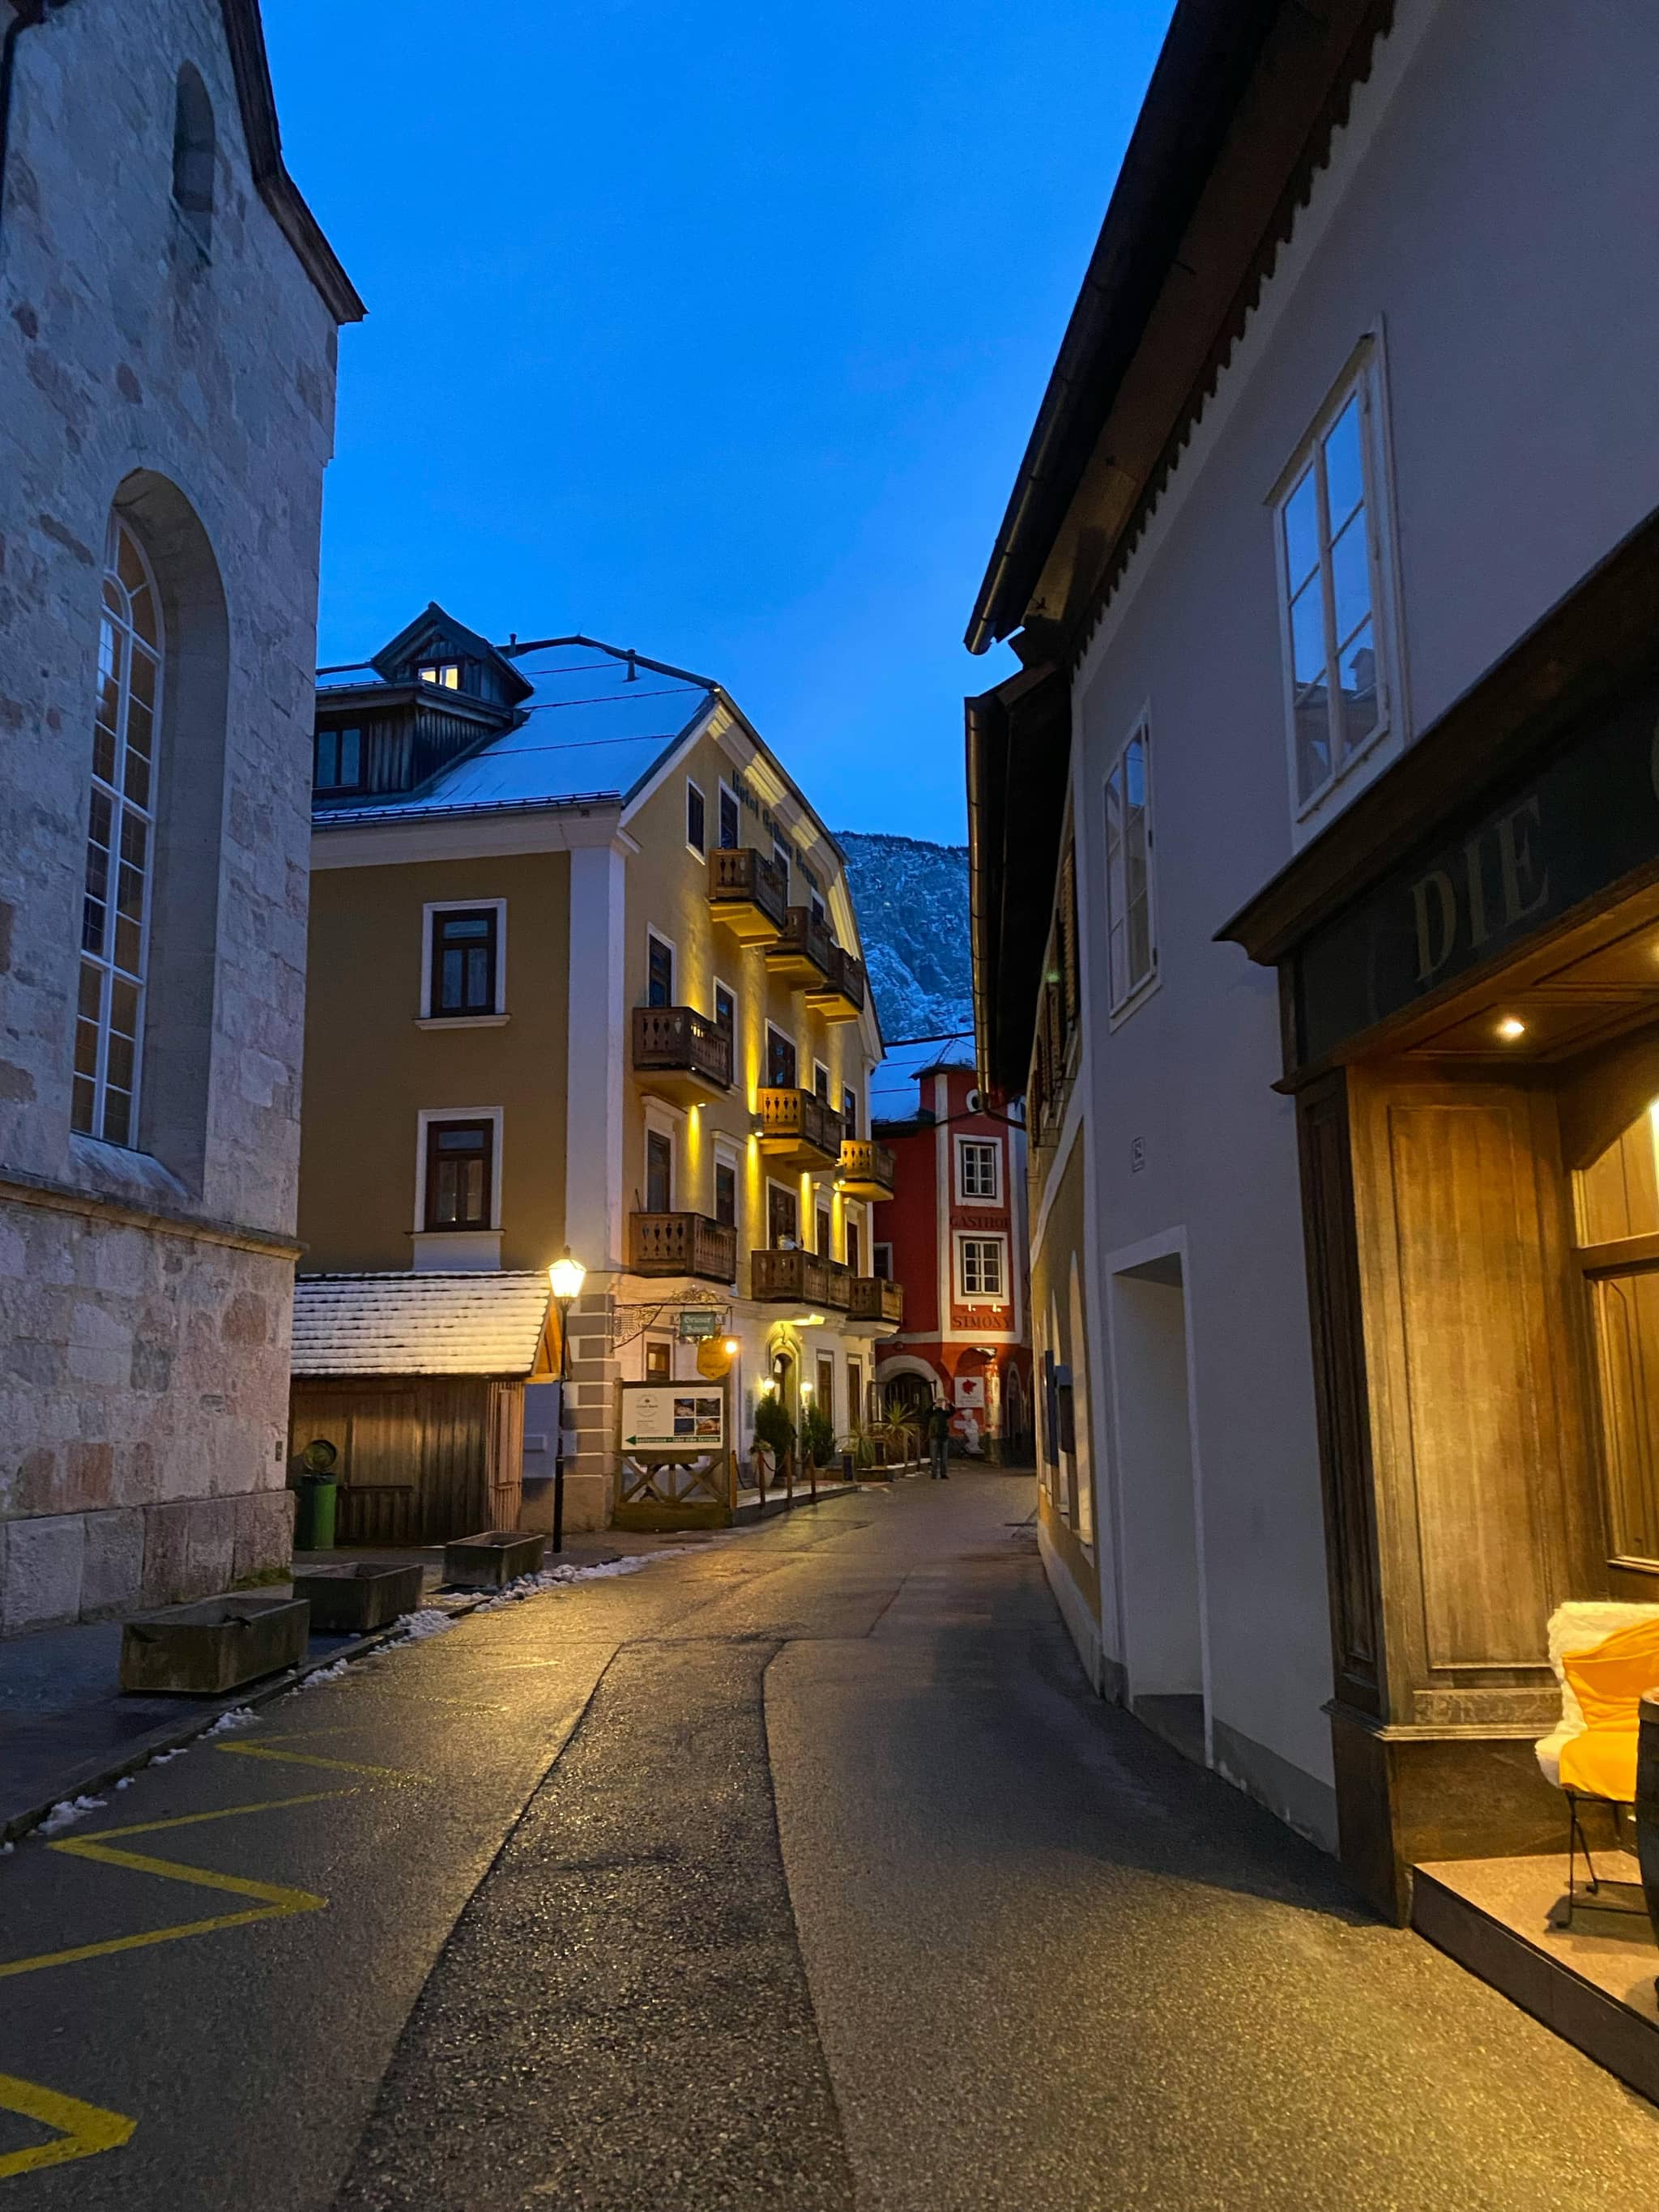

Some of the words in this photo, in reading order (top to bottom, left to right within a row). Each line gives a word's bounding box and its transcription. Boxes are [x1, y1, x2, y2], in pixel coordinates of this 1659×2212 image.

[1412, 795, 1550, 983] DIE
[949, 1216, 1009, 1229] GASTHOF
[952, 1315, 1010, 1329] SIMONY
